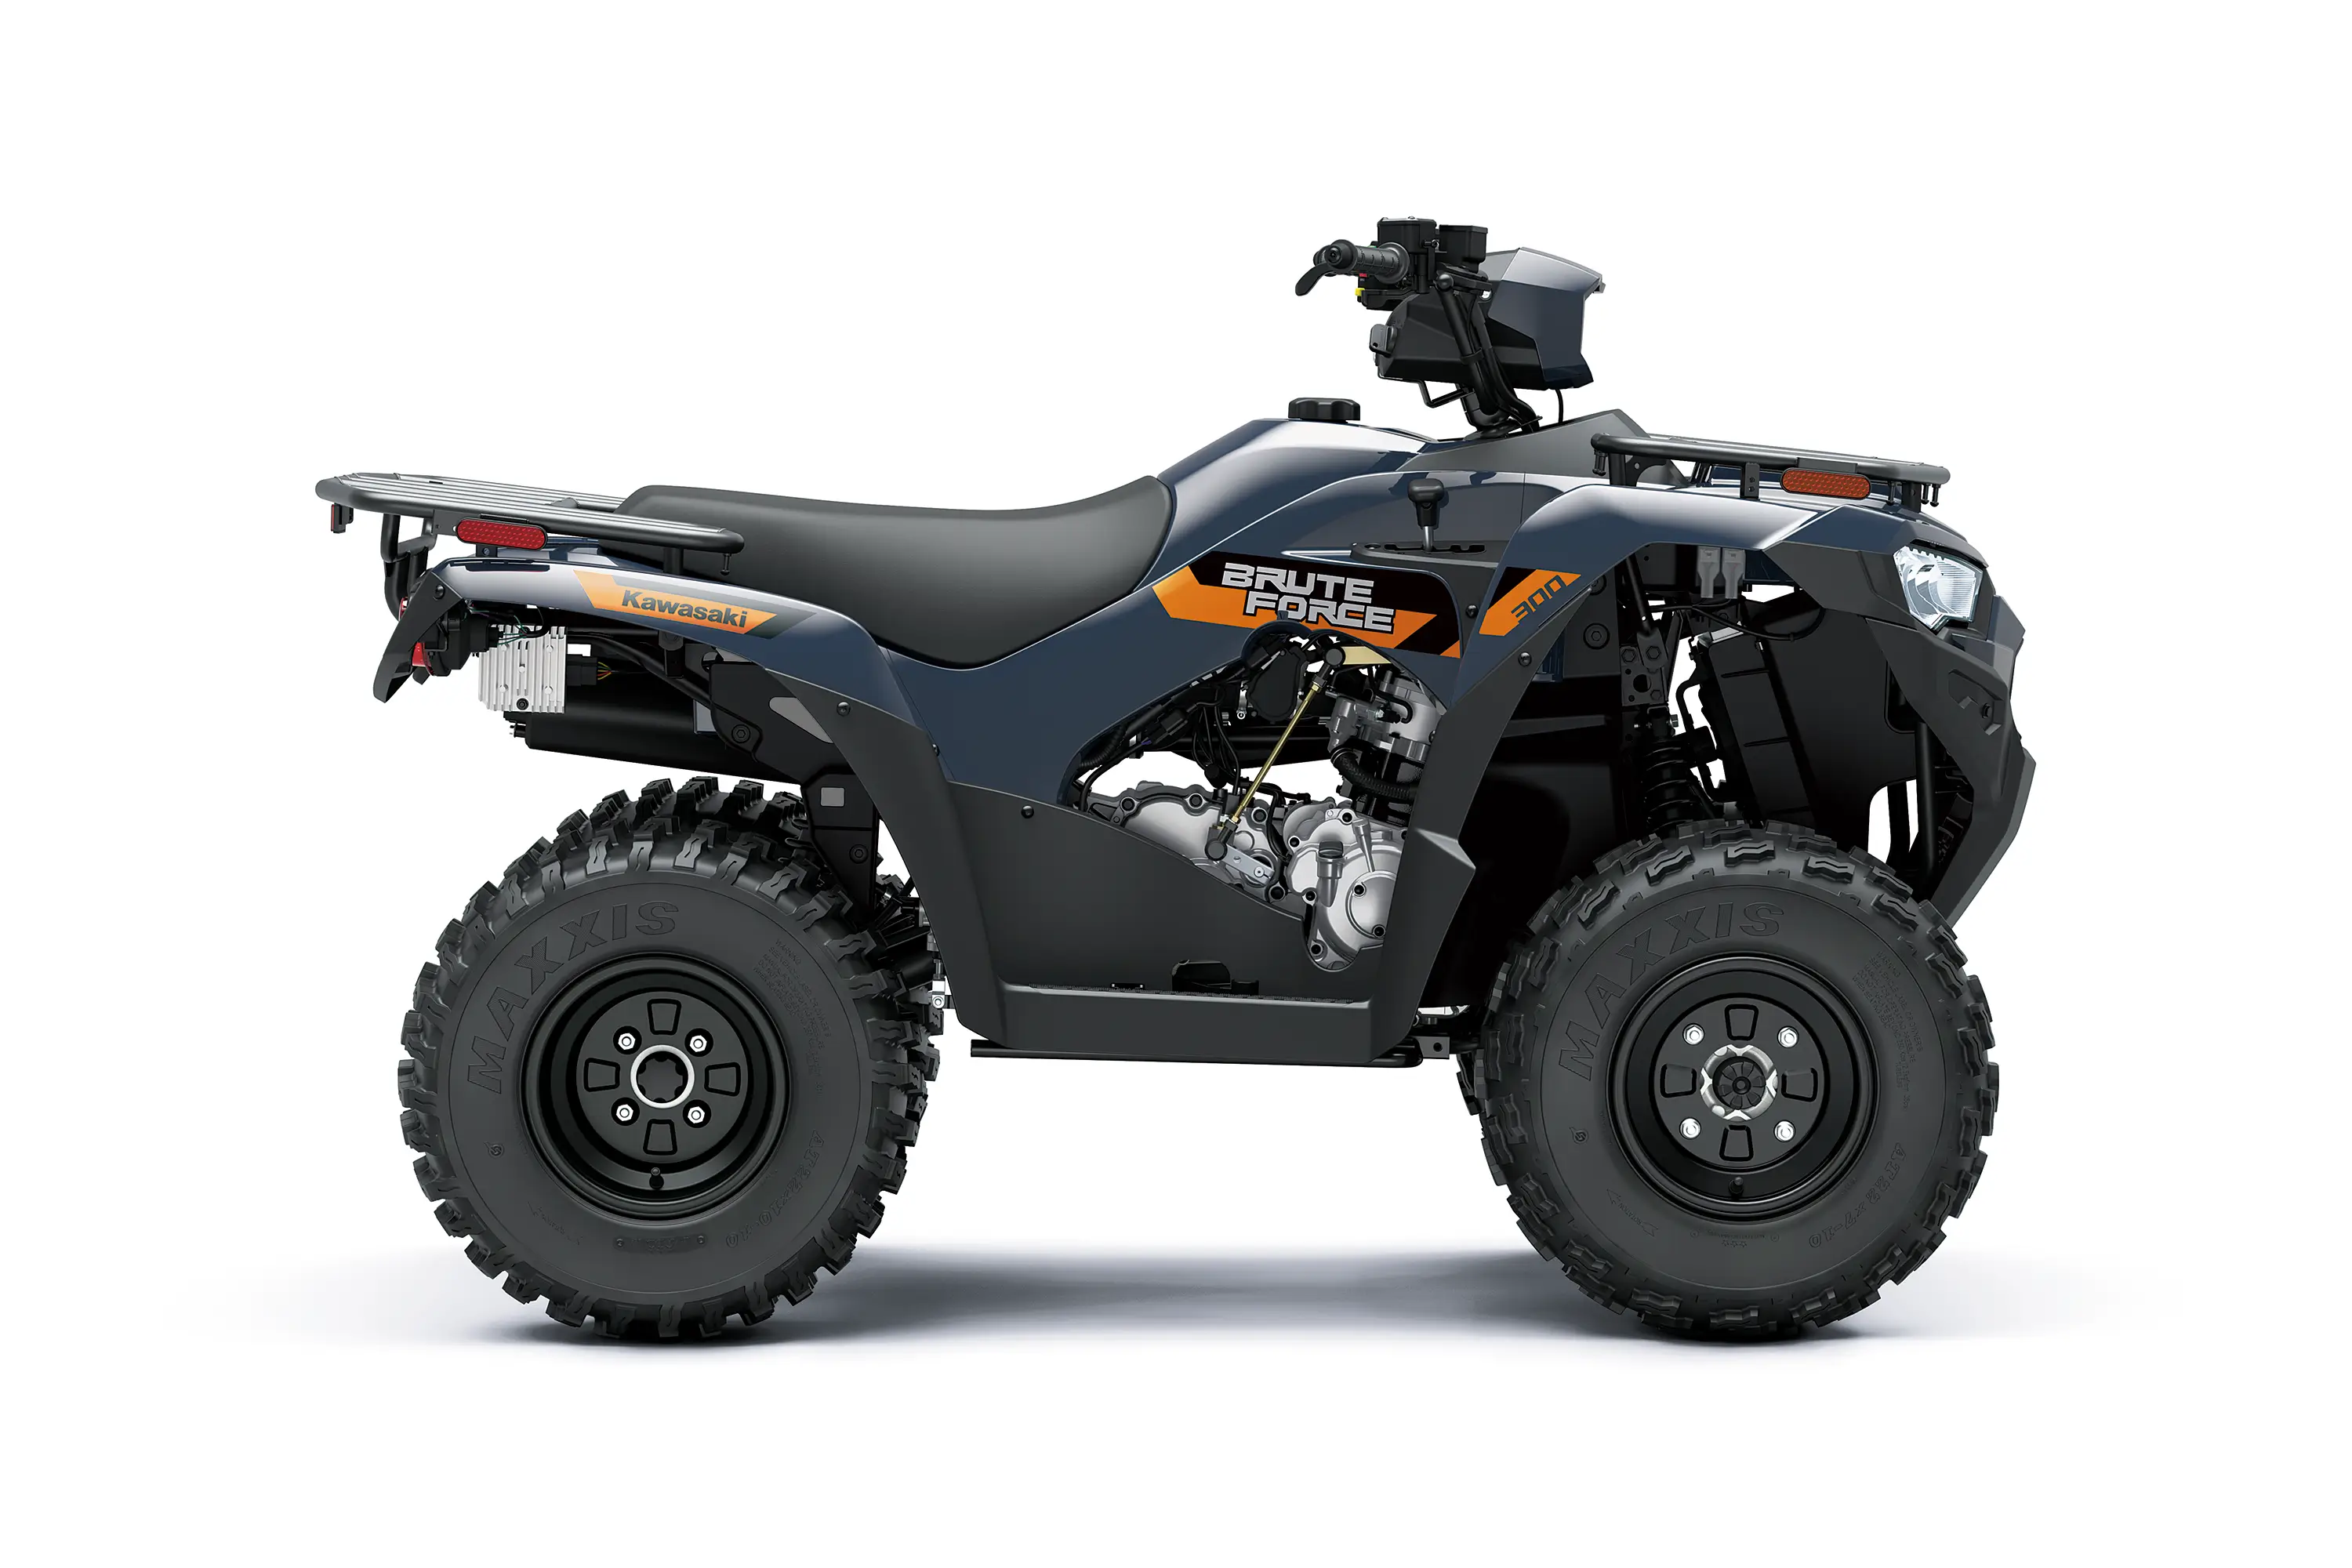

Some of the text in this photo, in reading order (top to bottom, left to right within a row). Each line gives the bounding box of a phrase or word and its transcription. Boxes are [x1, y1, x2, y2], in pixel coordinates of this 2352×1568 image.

[1221, 562, 1374, 604] BRUTE
[1510, 574, 1567, 620] 300
[621, 590, 748, 628] Kawasaki
[1245, 590, 1396, 633] FORCE
[467, 901, 679, 1094] MAXXIS
[1559, 902, 1784, 1081] MAXXIS
